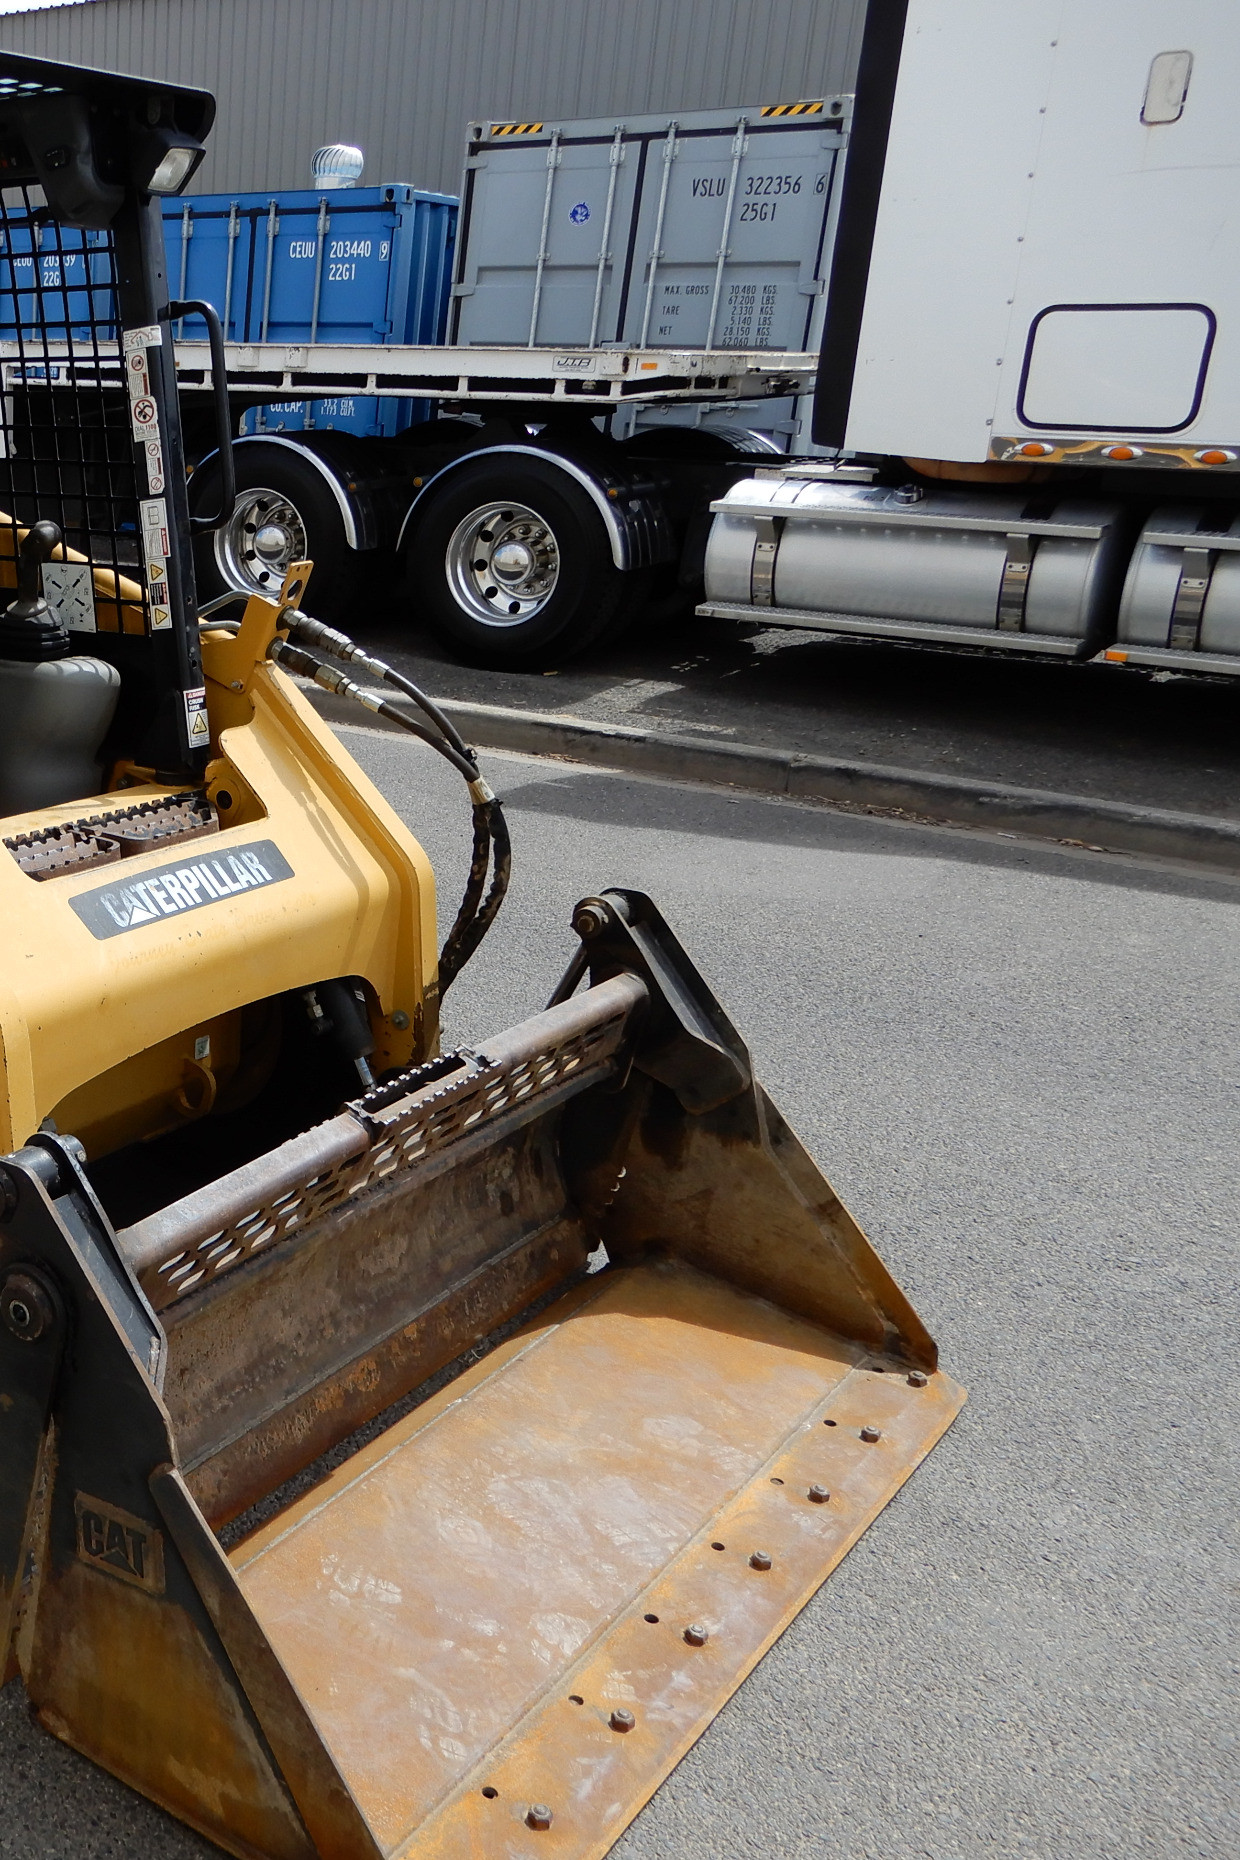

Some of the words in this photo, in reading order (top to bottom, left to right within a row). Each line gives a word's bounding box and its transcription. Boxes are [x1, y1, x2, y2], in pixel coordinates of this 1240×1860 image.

[692, 178, 726, 197] VSLU
[745, 175, 802, 195] 322356
[740, 202, 777, 222] 25G1
[289, 241, 316, 259] CEUU
[329, 240, 371, 258] 203440
[328, 263, 356, 281] 22G1
[664, 285, 682, 295] MAX.
[685, 285, 710, 295] GROSS
[662, 305, 680, 316] TARE
[658, 326, 673, 336] NET
[99, 850, 273, 928] CATERPILLAR
[82, 1510, 147, 1578] CAT
